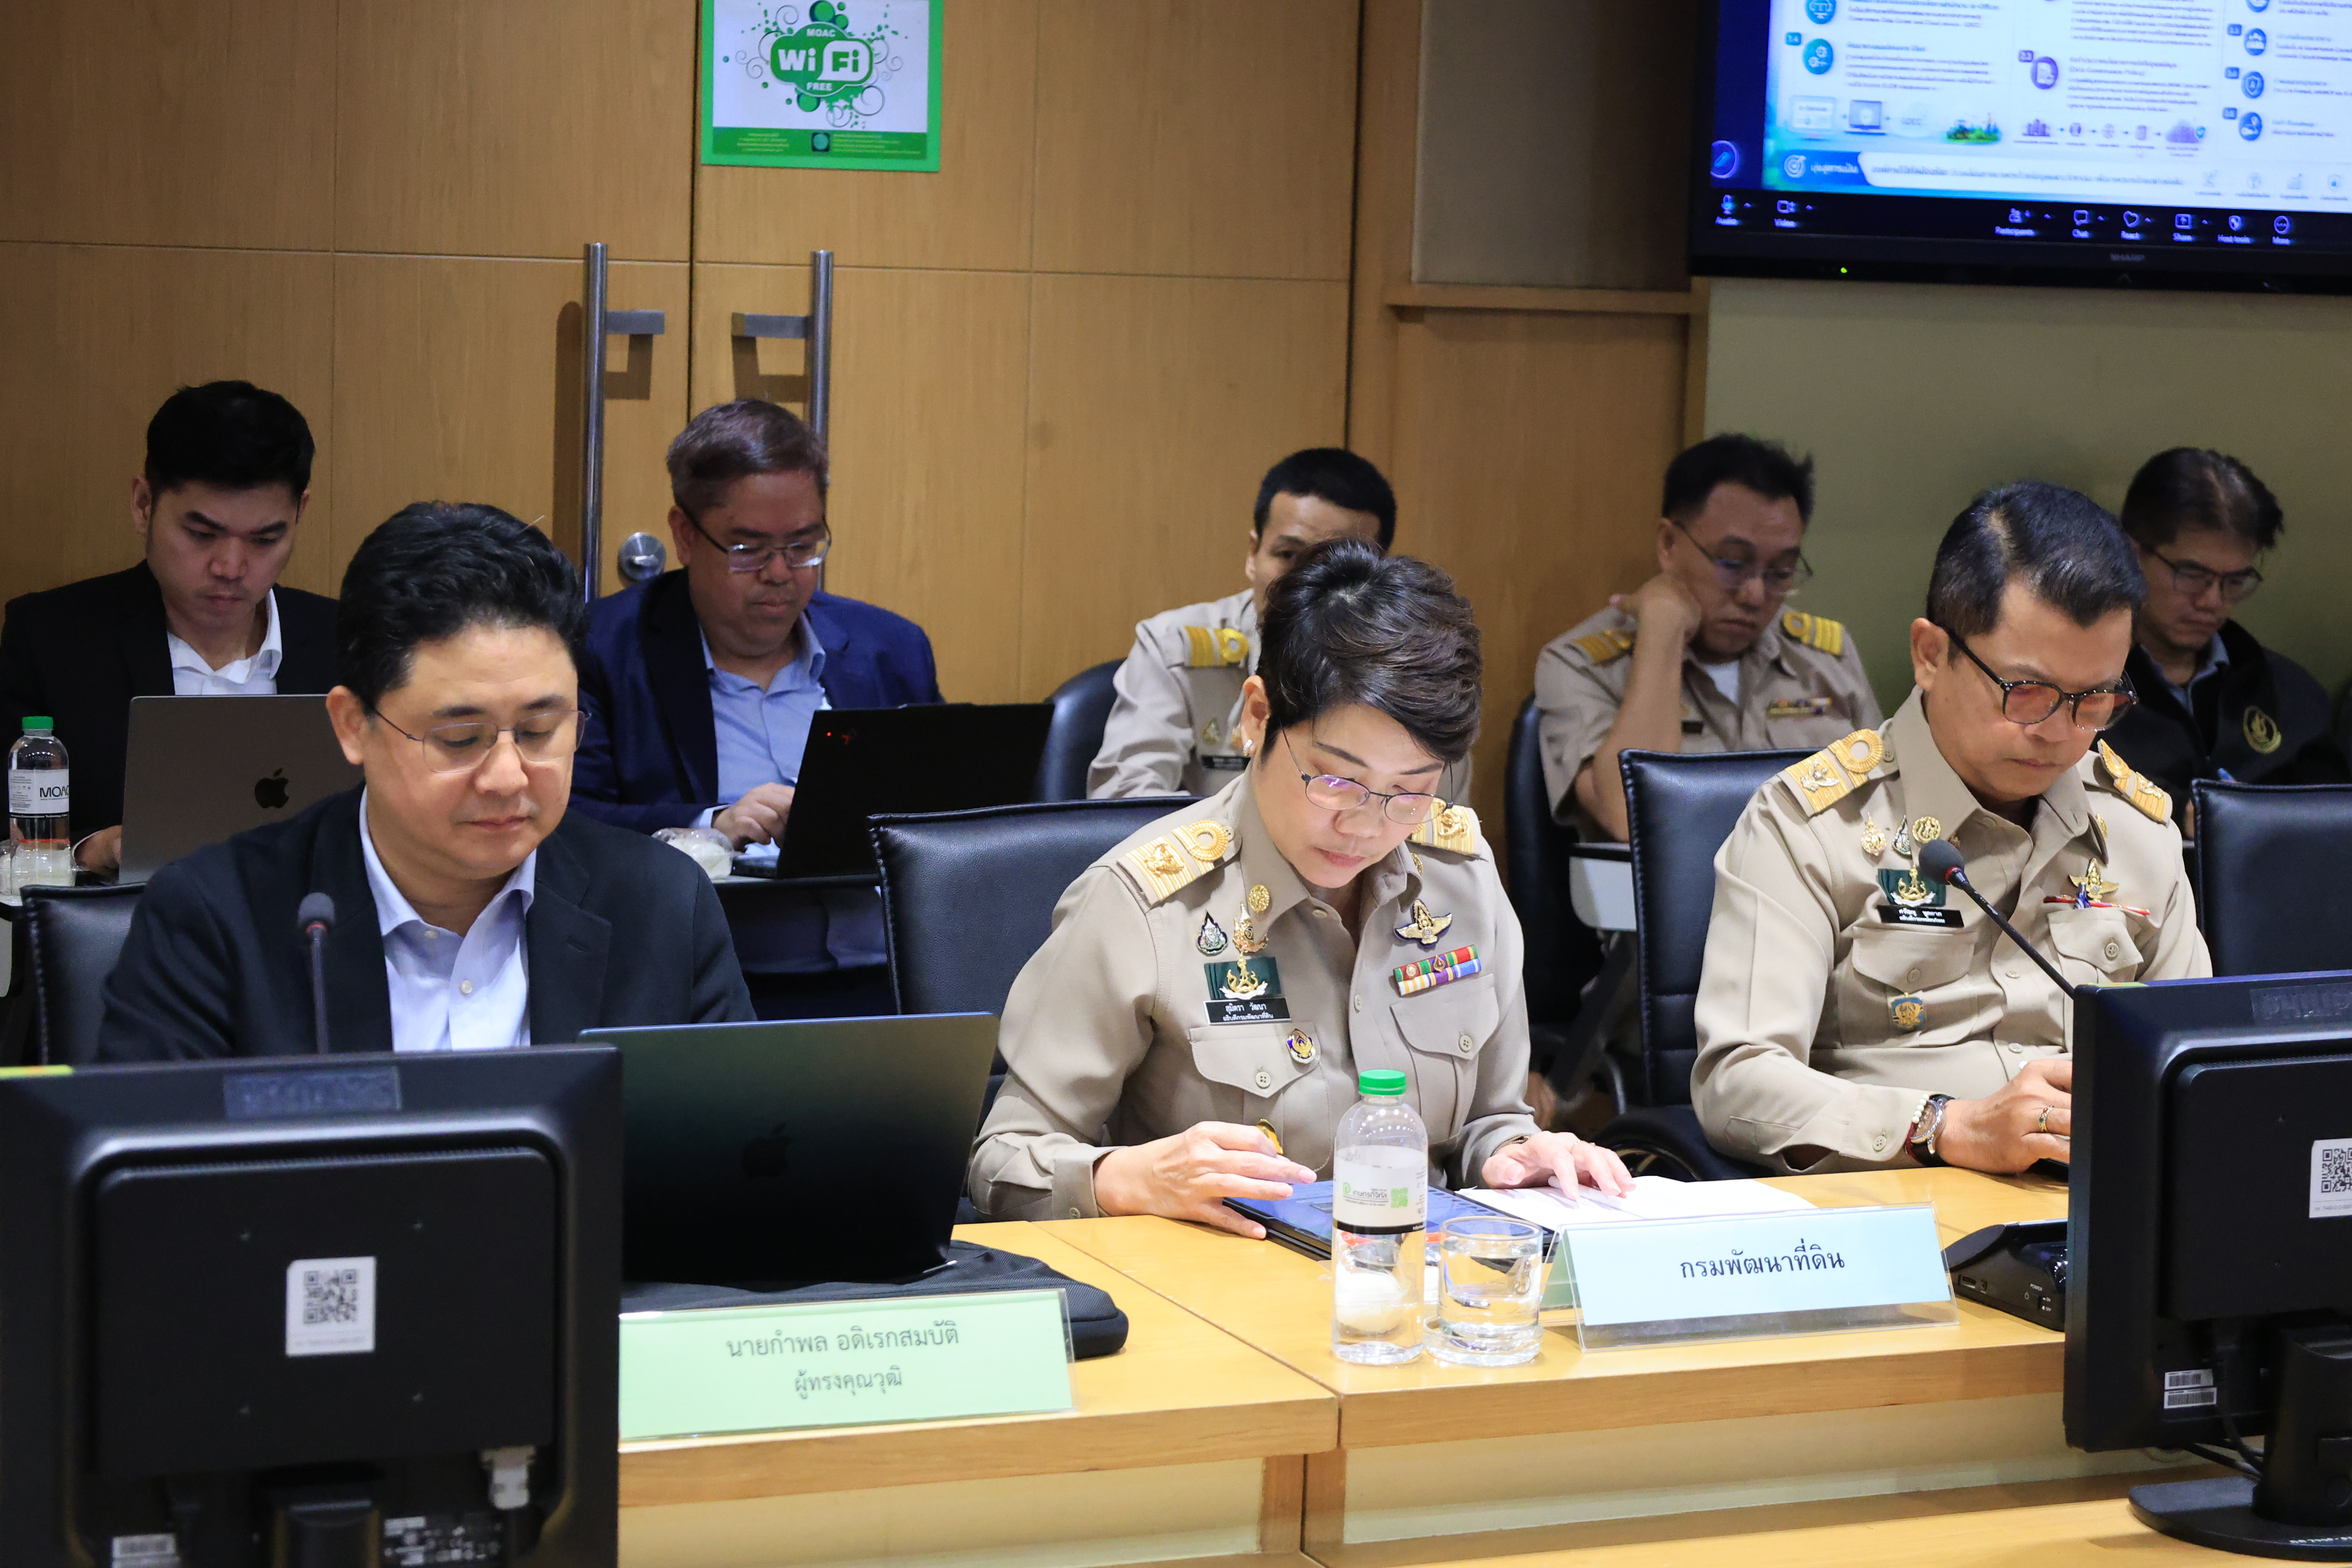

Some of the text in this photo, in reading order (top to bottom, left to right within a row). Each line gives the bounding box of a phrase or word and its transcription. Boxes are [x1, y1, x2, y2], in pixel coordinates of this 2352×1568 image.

[806, 28, 837, 38] MOAC
[778, 47, 860, 73] Wi Fi
[806, 81, 833, 92] FREE
[1773, 218, 1797, 228] Video
[1679, 1238, 1845, 1279] กรมพัฒนาที่ดิน
[2030, 1283, 2043, 1291] POWER
[726, 1319, 960, 1358] นายกำพล อดิเรกสมบัติ
[793, 1364, 903, 1400] ผู้ทรงคุณวุฒิ
